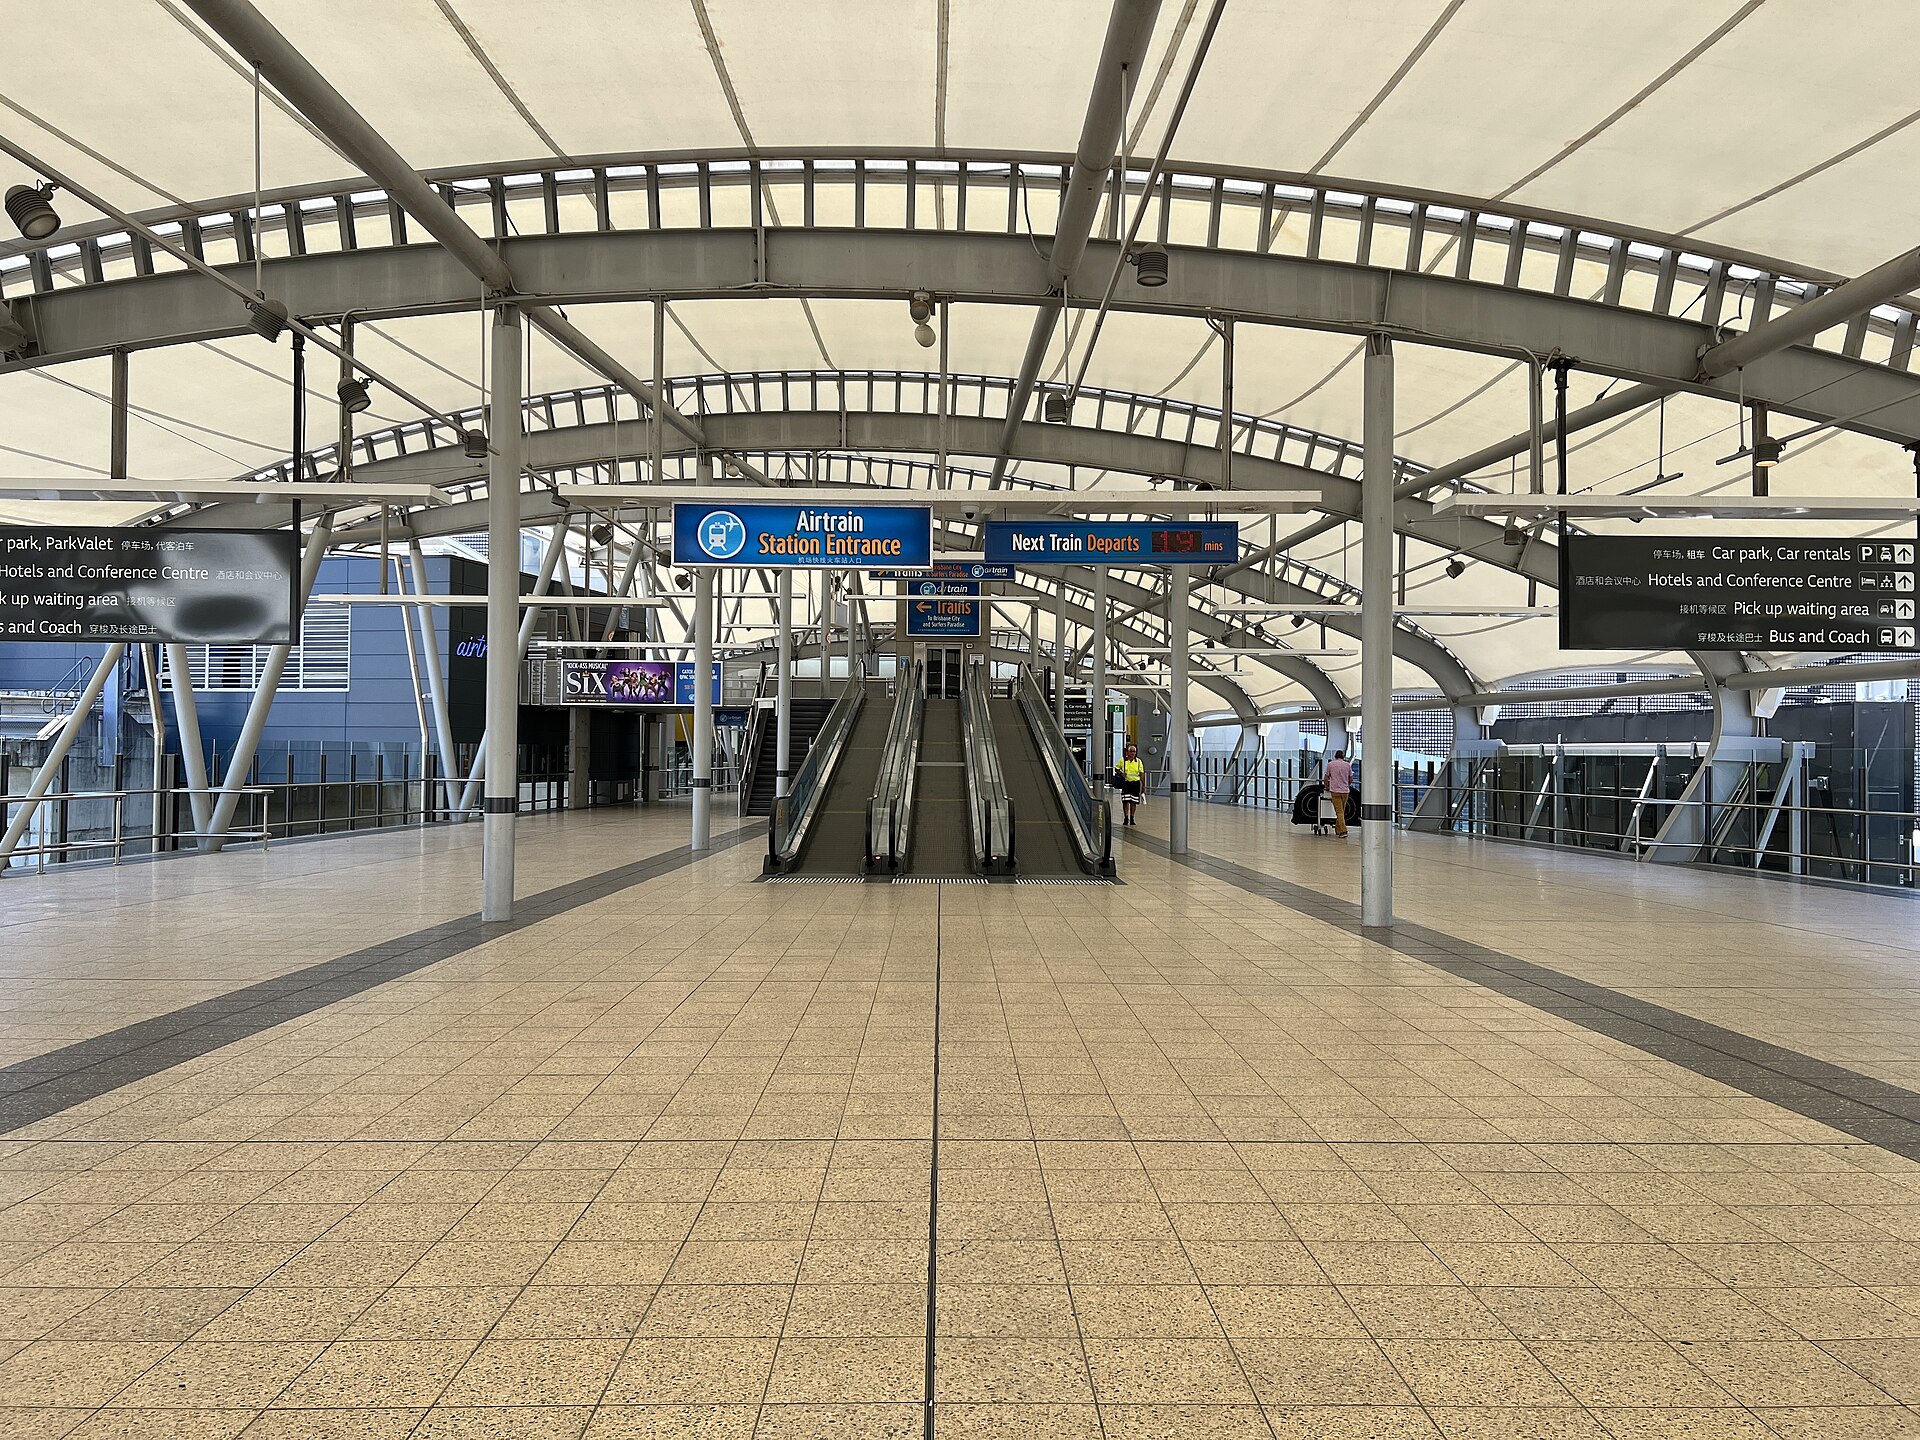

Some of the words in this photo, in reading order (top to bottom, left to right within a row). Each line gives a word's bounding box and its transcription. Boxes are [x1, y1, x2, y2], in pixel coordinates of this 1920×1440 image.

[796, 510, 864, 532] Airtrain
[7, 535, 42, 553] park,
[46, 535, 114, 551] ParkValet
[758, 533, 820, 555] Station
[826, 533, 902, 556] Entrance
[1012, 533, 1045, 551] Next
[1049, 533, 1083, 551] Train
[1086, 533, 1140, 554] Departs
[1204, 540, 1224, 551] mins
[1712, 546, 1736, 560] Car
[1739, 546, 1773, 563] park,
[1776, 547, 1800, 561] Car
[1804, 546, 1851, 561] rentals
[0, 564, 44, 578] Hotels
[47, 563, 74, 578] and
[78, 564, 158, 579] Conference
[161, 566, 209, 580] Centre
[1575, 575, 1642, 586] 酒店和会议中心
[1648, 572, 1693, 587] Hotels
[1696, 572, 1724, 587] and
[1726, 573, 1804, 588] Conference
[1807, 575, 1852, 588] Centre
[11, 594, 30, 609] up
[33, 592, 84, 610] waiting
[88, 594, 119, 606] area
[1733, 600, 1762, 615] Pick
[1765, 604, 1783, 618] up
[1786, 601, 1837, 619] waiting
[1840, 604, 1870, 616] area
[8, 619, 36, 634] and
[39, 619, 82, 635] Coach
[1769, 628, 1795, 643] Bus
[1798, 628, 1825, 643] and
[1828, 629, 1870, 644] Coach
